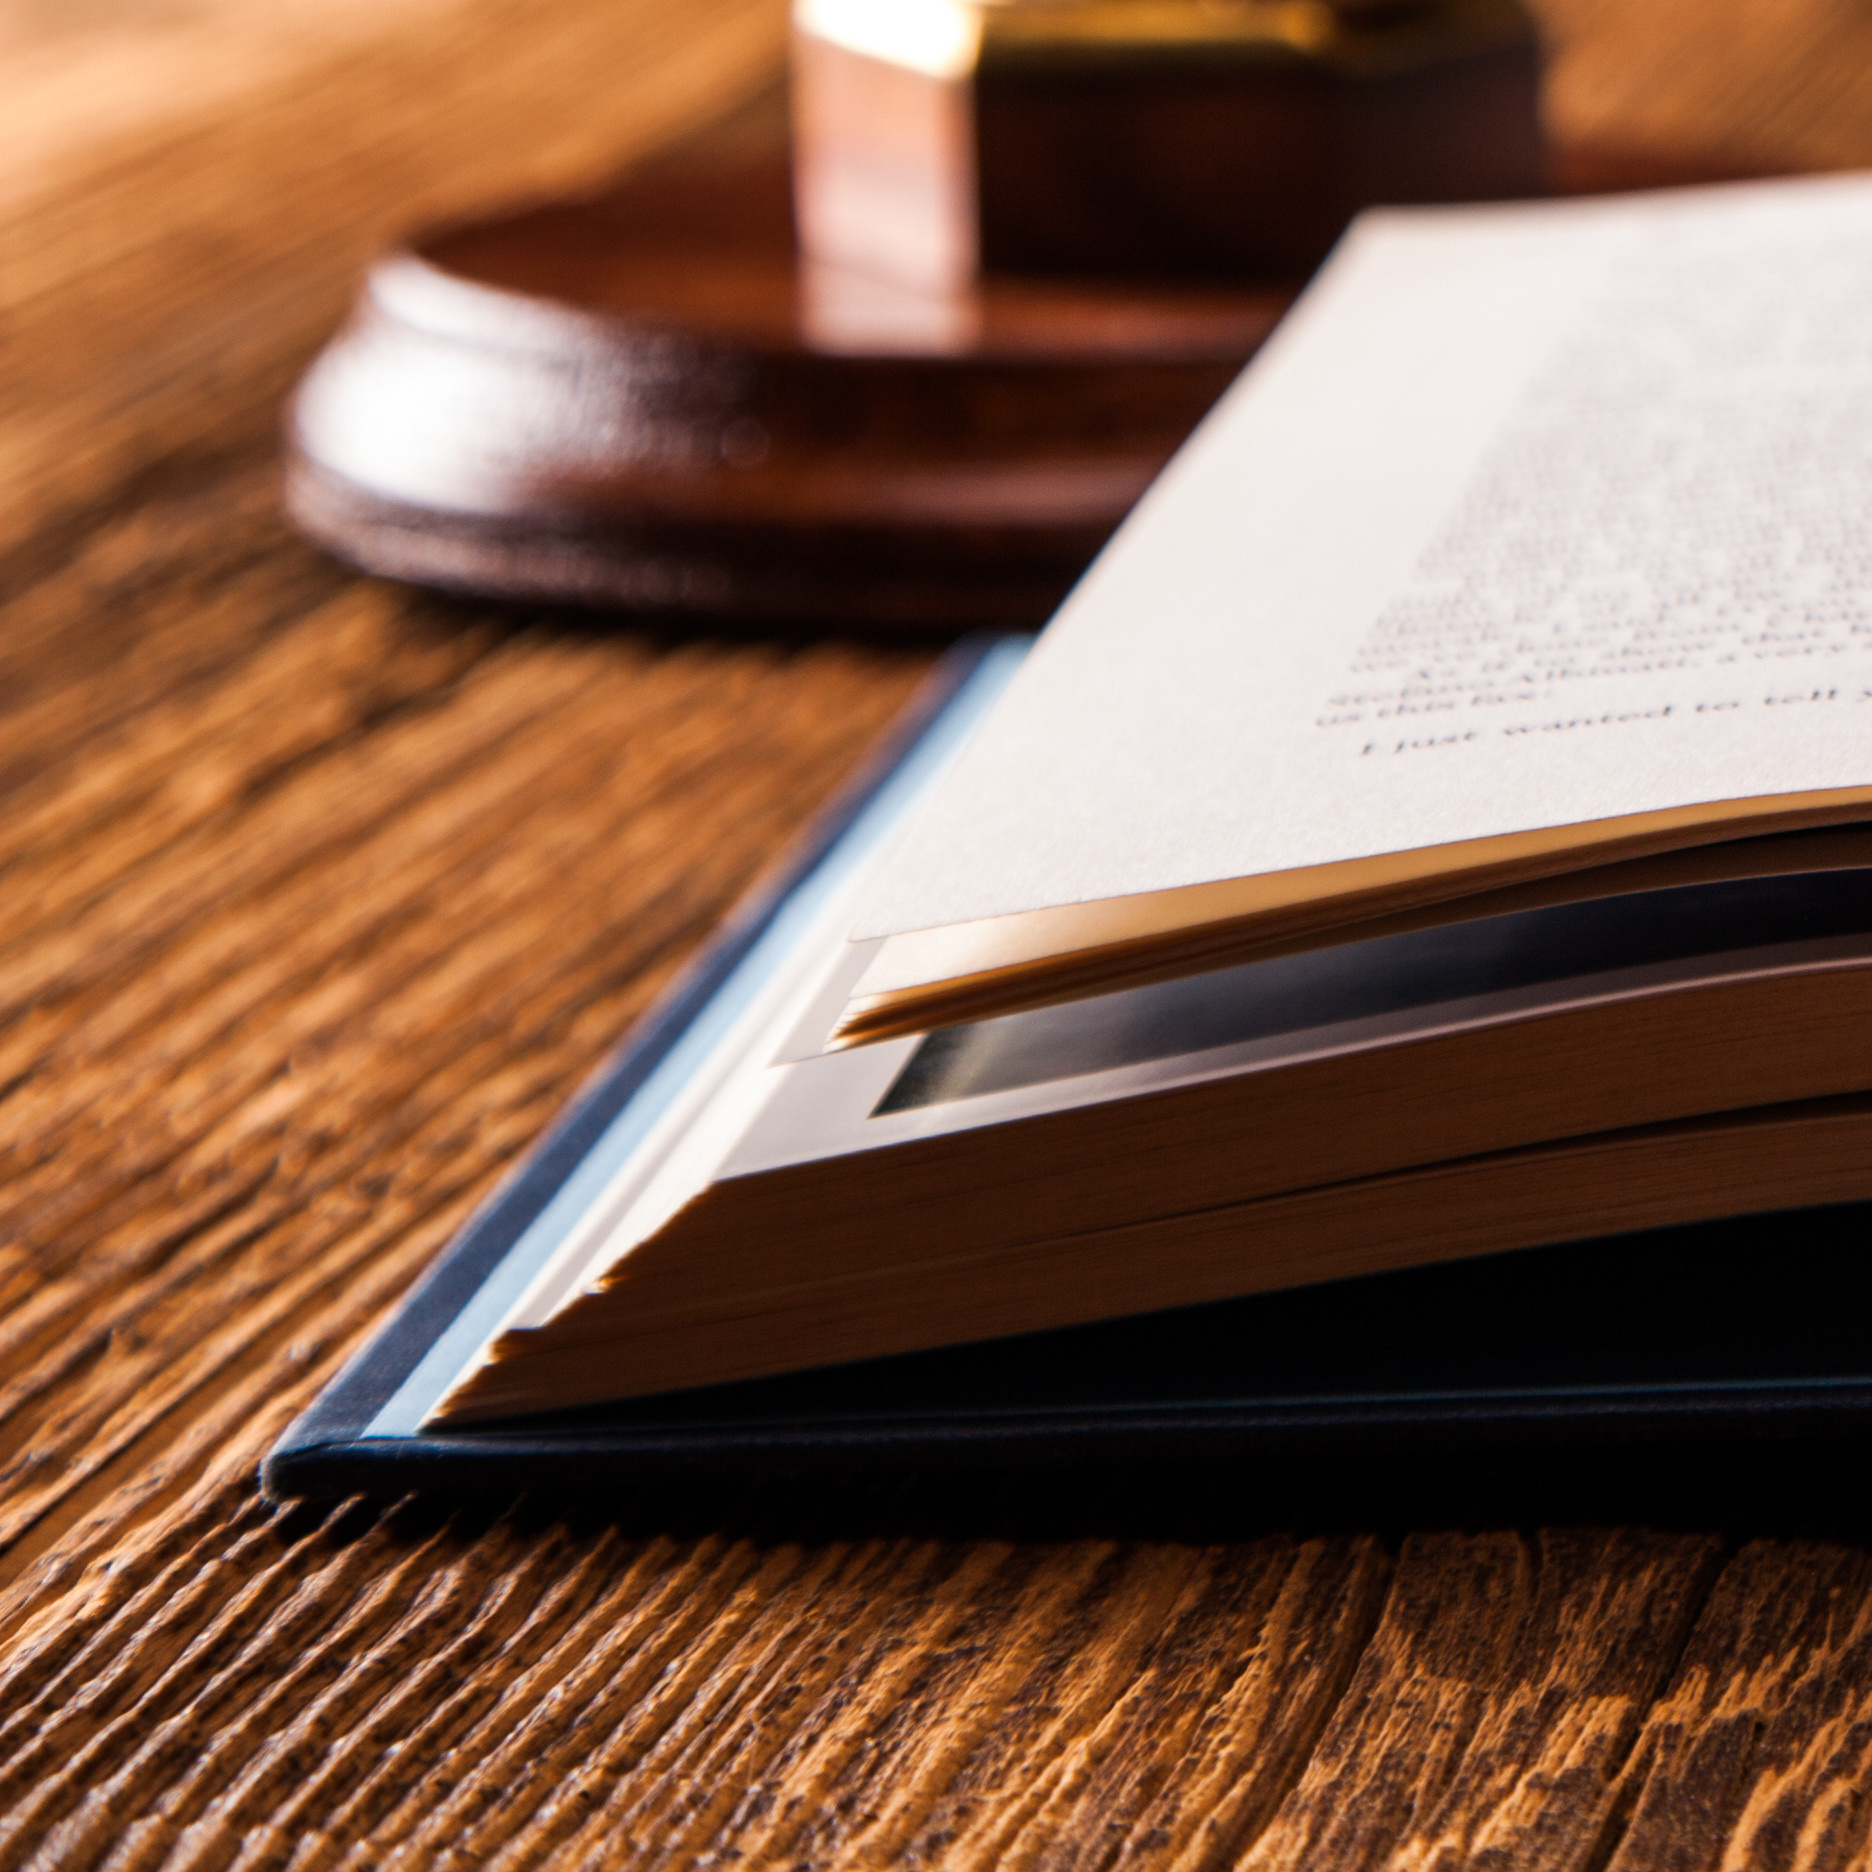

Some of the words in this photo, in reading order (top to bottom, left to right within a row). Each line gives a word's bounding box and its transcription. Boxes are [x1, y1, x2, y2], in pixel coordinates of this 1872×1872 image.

[1361, 742, 1375, 756] I
[1394, 730, 1478, 754] just
[1502, 704, 1675, 737] wanted
[1694, 700, 1741, 714] to
[1763, 687, 1838, 706] tell
